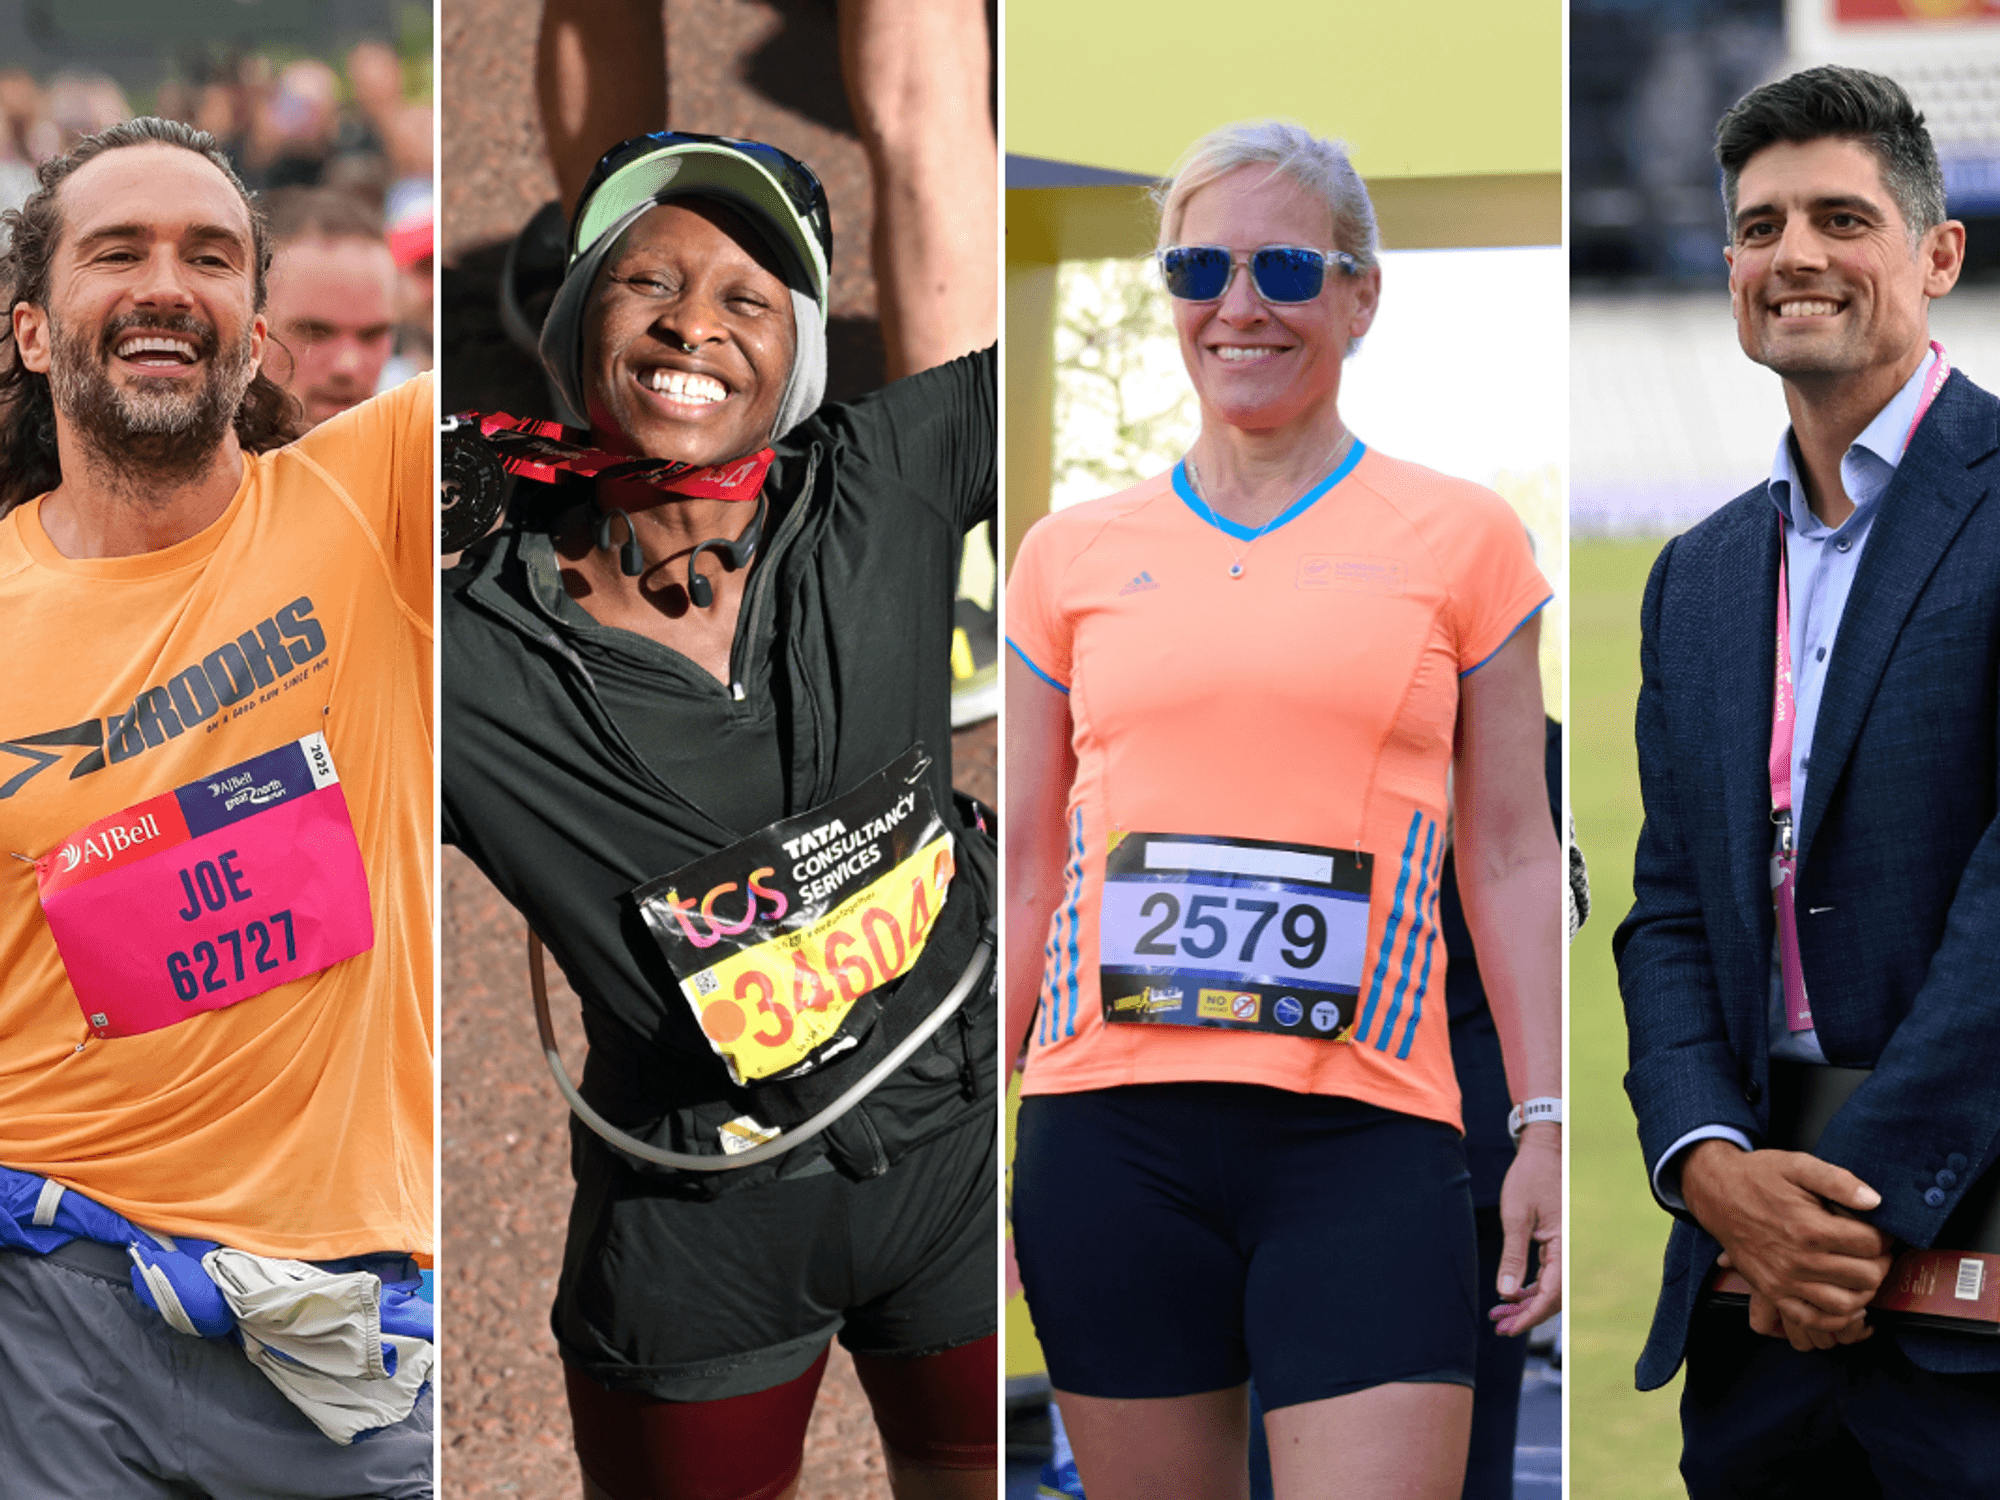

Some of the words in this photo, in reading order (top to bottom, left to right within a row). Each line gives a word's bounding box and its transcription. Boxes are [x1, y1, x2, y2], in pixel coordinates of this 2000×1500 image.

[106, 596, 327, 764] BROOKS
[310, 744, 330, 776] 2025
[782, 818, 847, 860] TATA
[792, 791, 916, 883] CONSULTANCY
[798, 843, 882, 905] SERVICES
[178, 849, 253, 922] JOE
[166, 908, 298, 1002] 62727
[733, 876, 931, 1048] 34604
[1133, 891, 1328, 970] 2579
[1206, 994, 1228, 1007] NO
